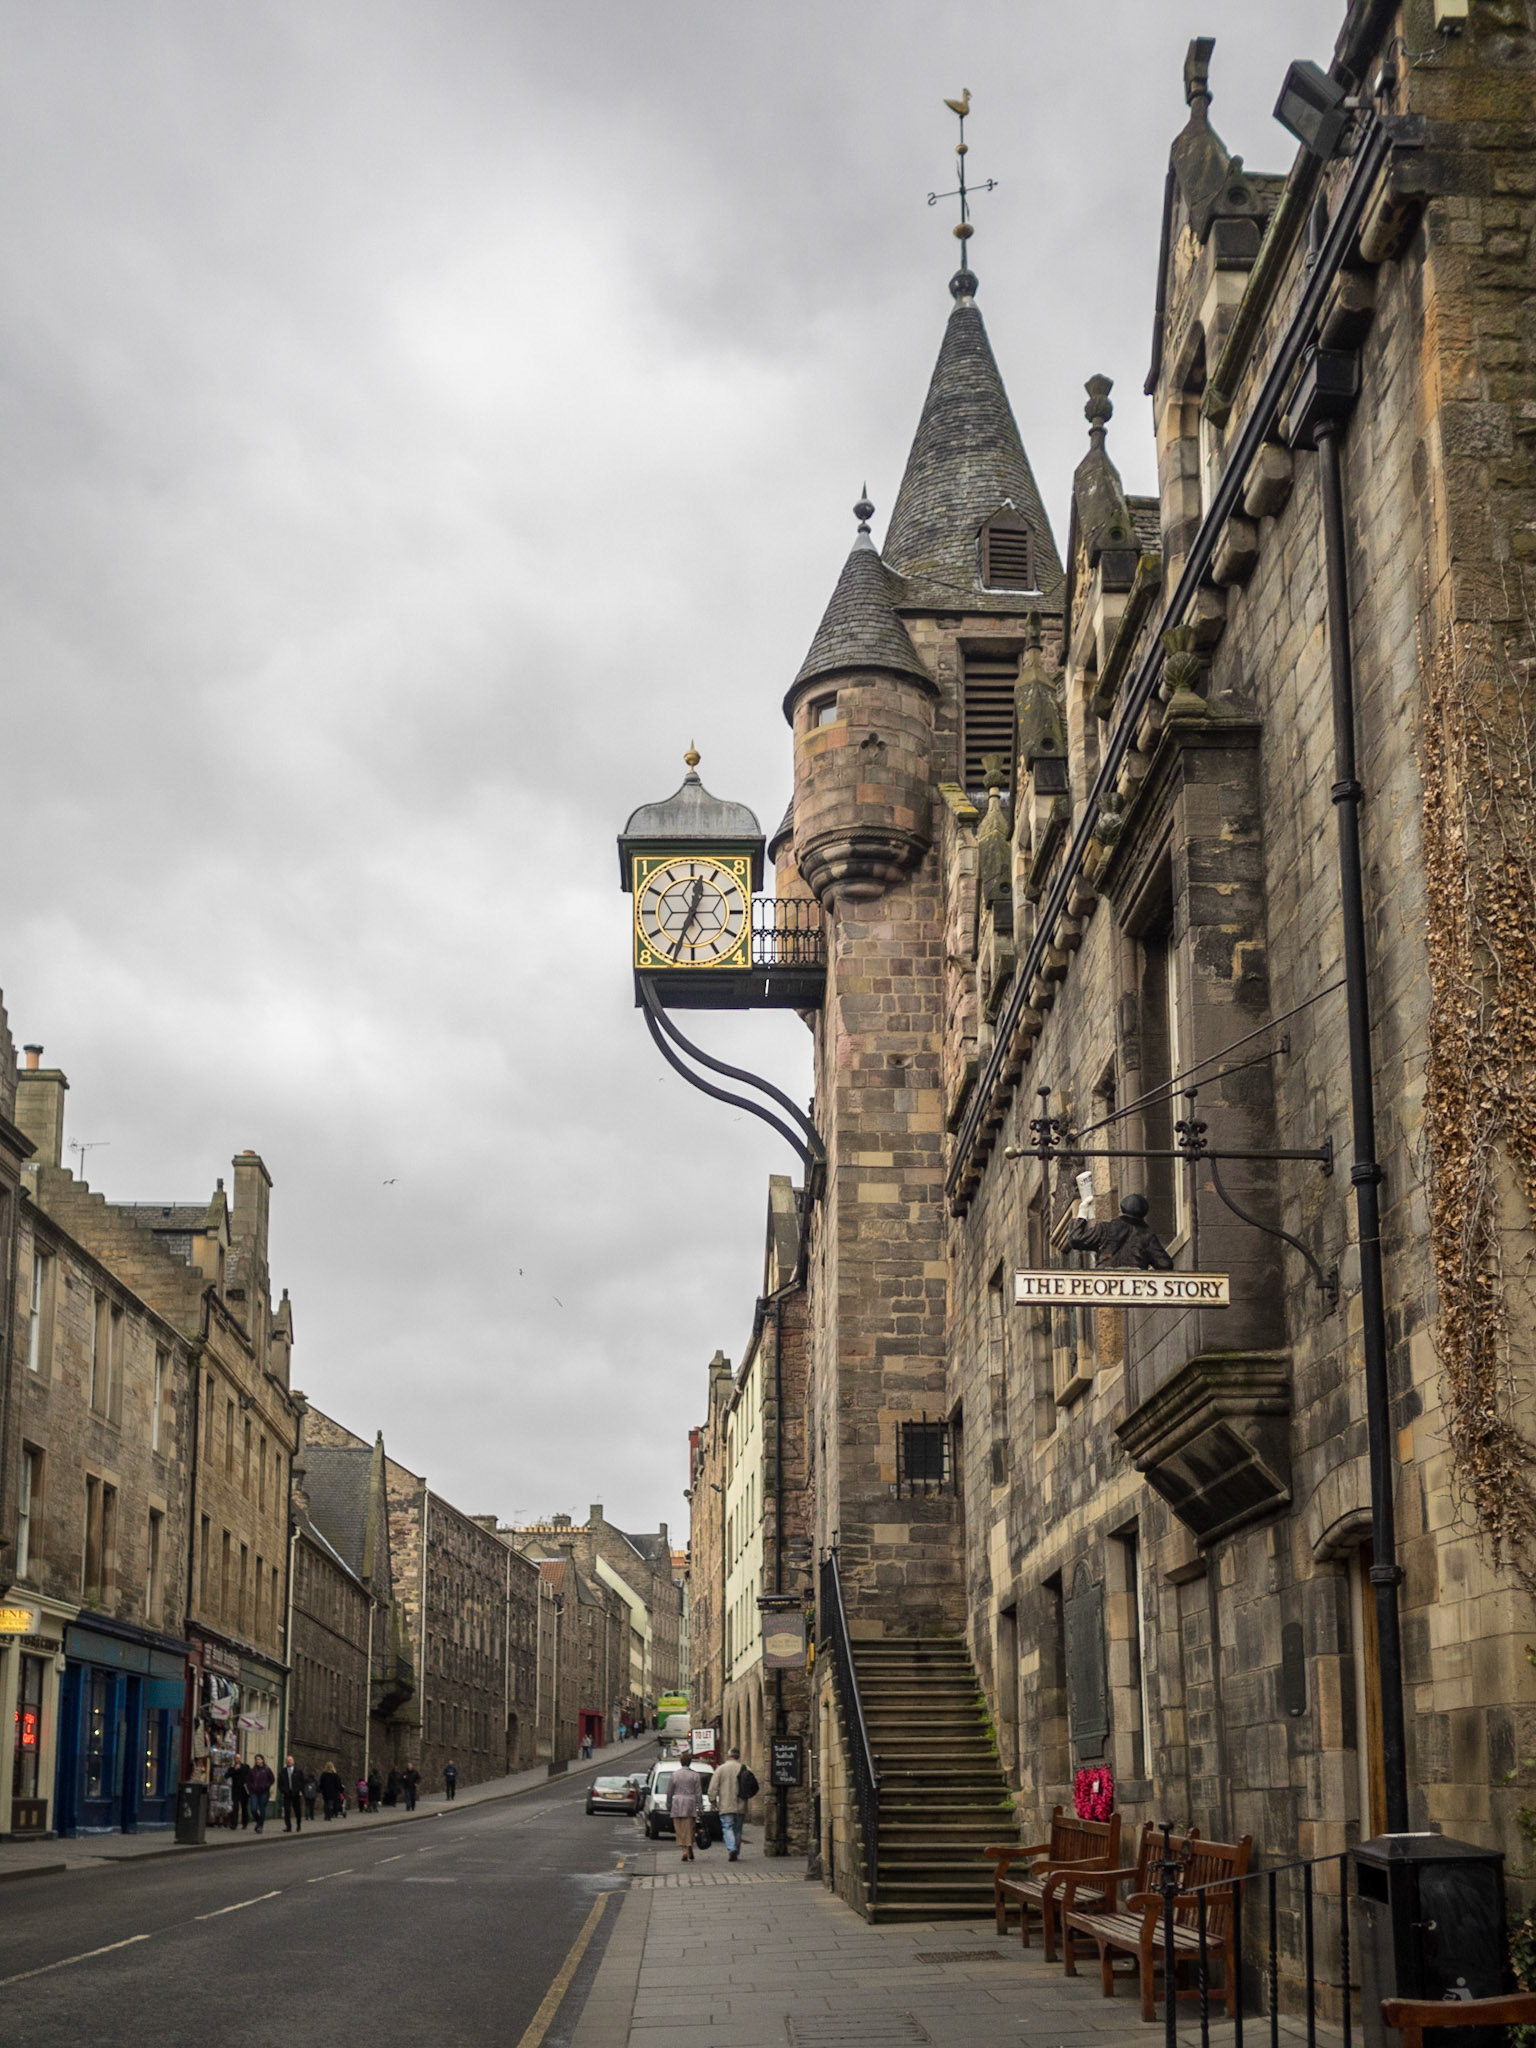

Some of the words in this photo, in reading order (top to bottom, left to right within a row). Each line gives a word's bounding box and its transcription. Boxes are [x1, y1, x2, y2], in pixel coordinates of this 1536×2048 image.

[642, 860, 649, 875] 1
[733, 860, 745, 875] 8
[639, 950, 652, 964] 8
[732, 949, 745, 964] 4
[1023, 1277, 1066, 1295] THE
[1069, 1278, 1158, 1297] PEOPLE'S
[1163, 1280, 1224, 1299] STORY
